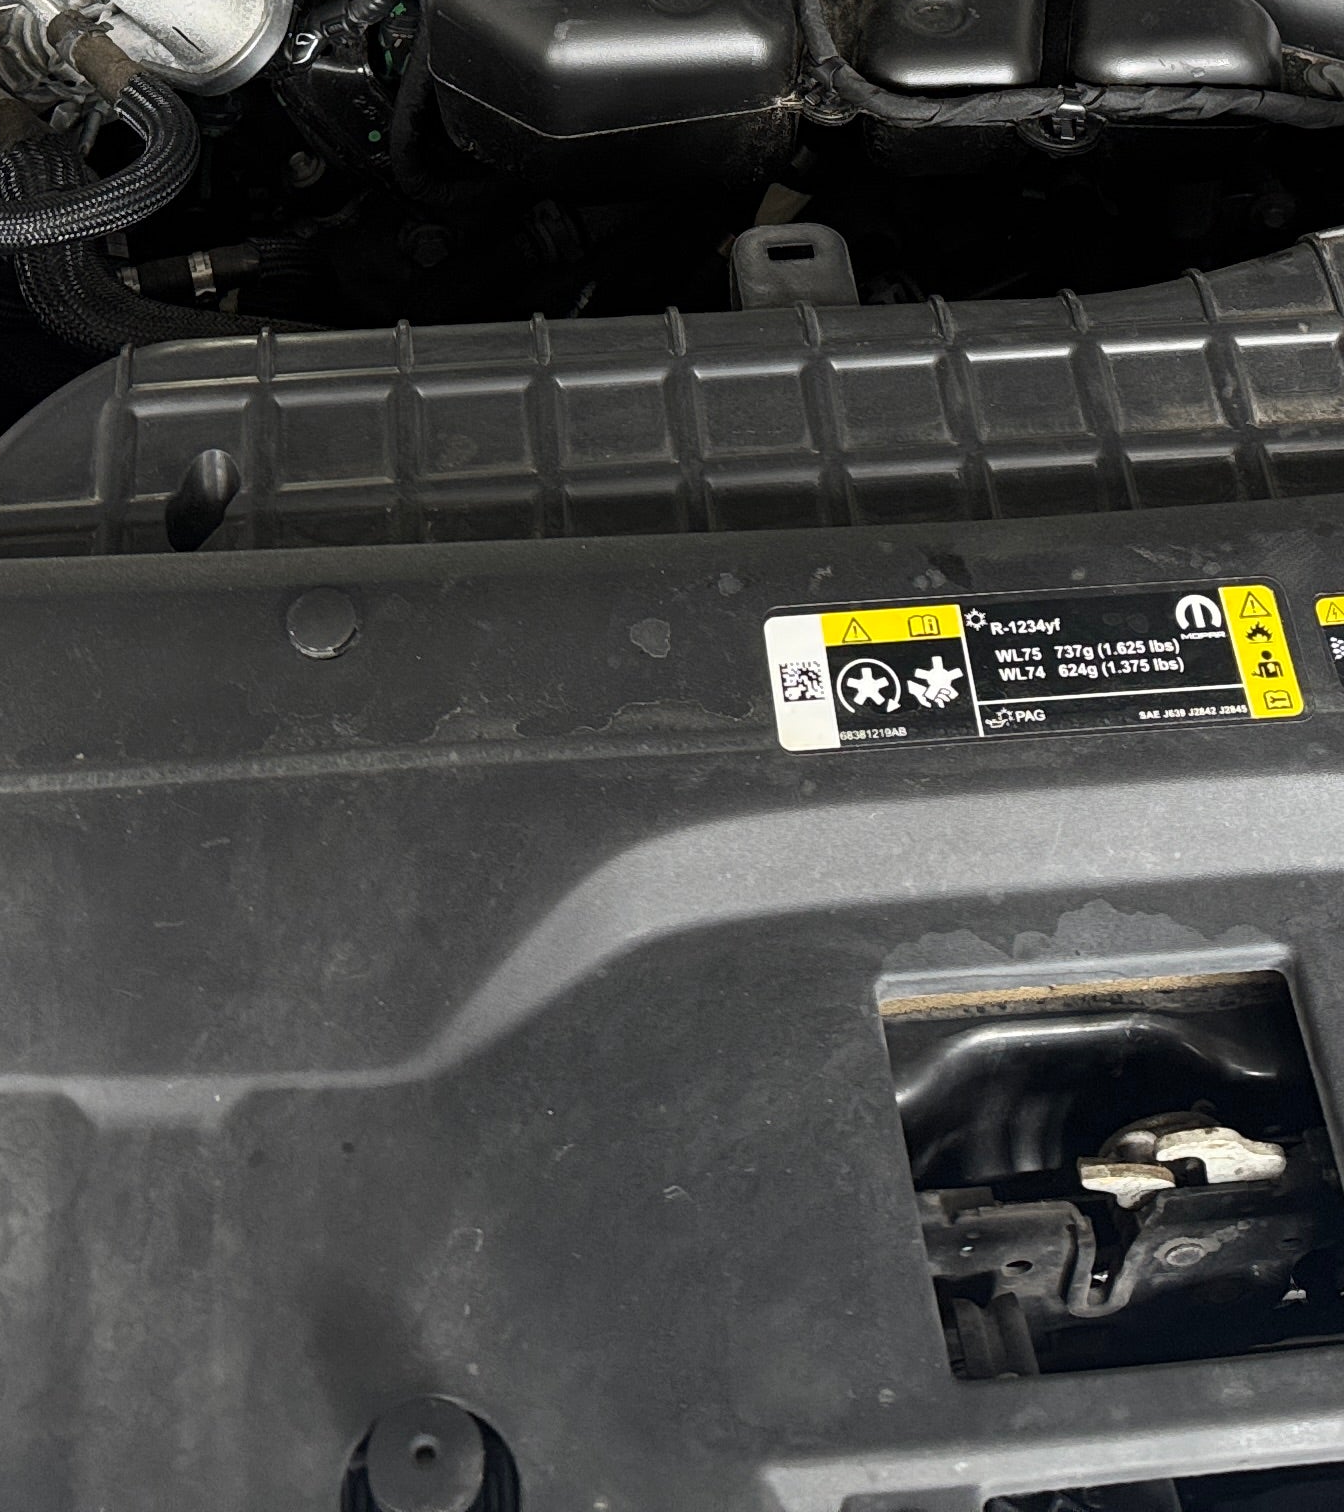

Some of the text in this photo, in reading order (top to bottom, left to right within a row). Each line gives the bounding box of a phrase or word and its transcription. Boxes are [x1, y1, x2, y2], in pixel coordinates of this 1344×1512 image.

[990, 618, 1061, 636] R-1234yf
[1180, 631, 1226, 640] MOPAR
[995, 637, 1180, 663] WL75 737g (1.625 lbs)
[999, 656, 1185, 681] WL74 624g (1.375 lbs)
[1016, 709, 1046, 722] PAG
[1138, 710, 1161, 719] SAE
